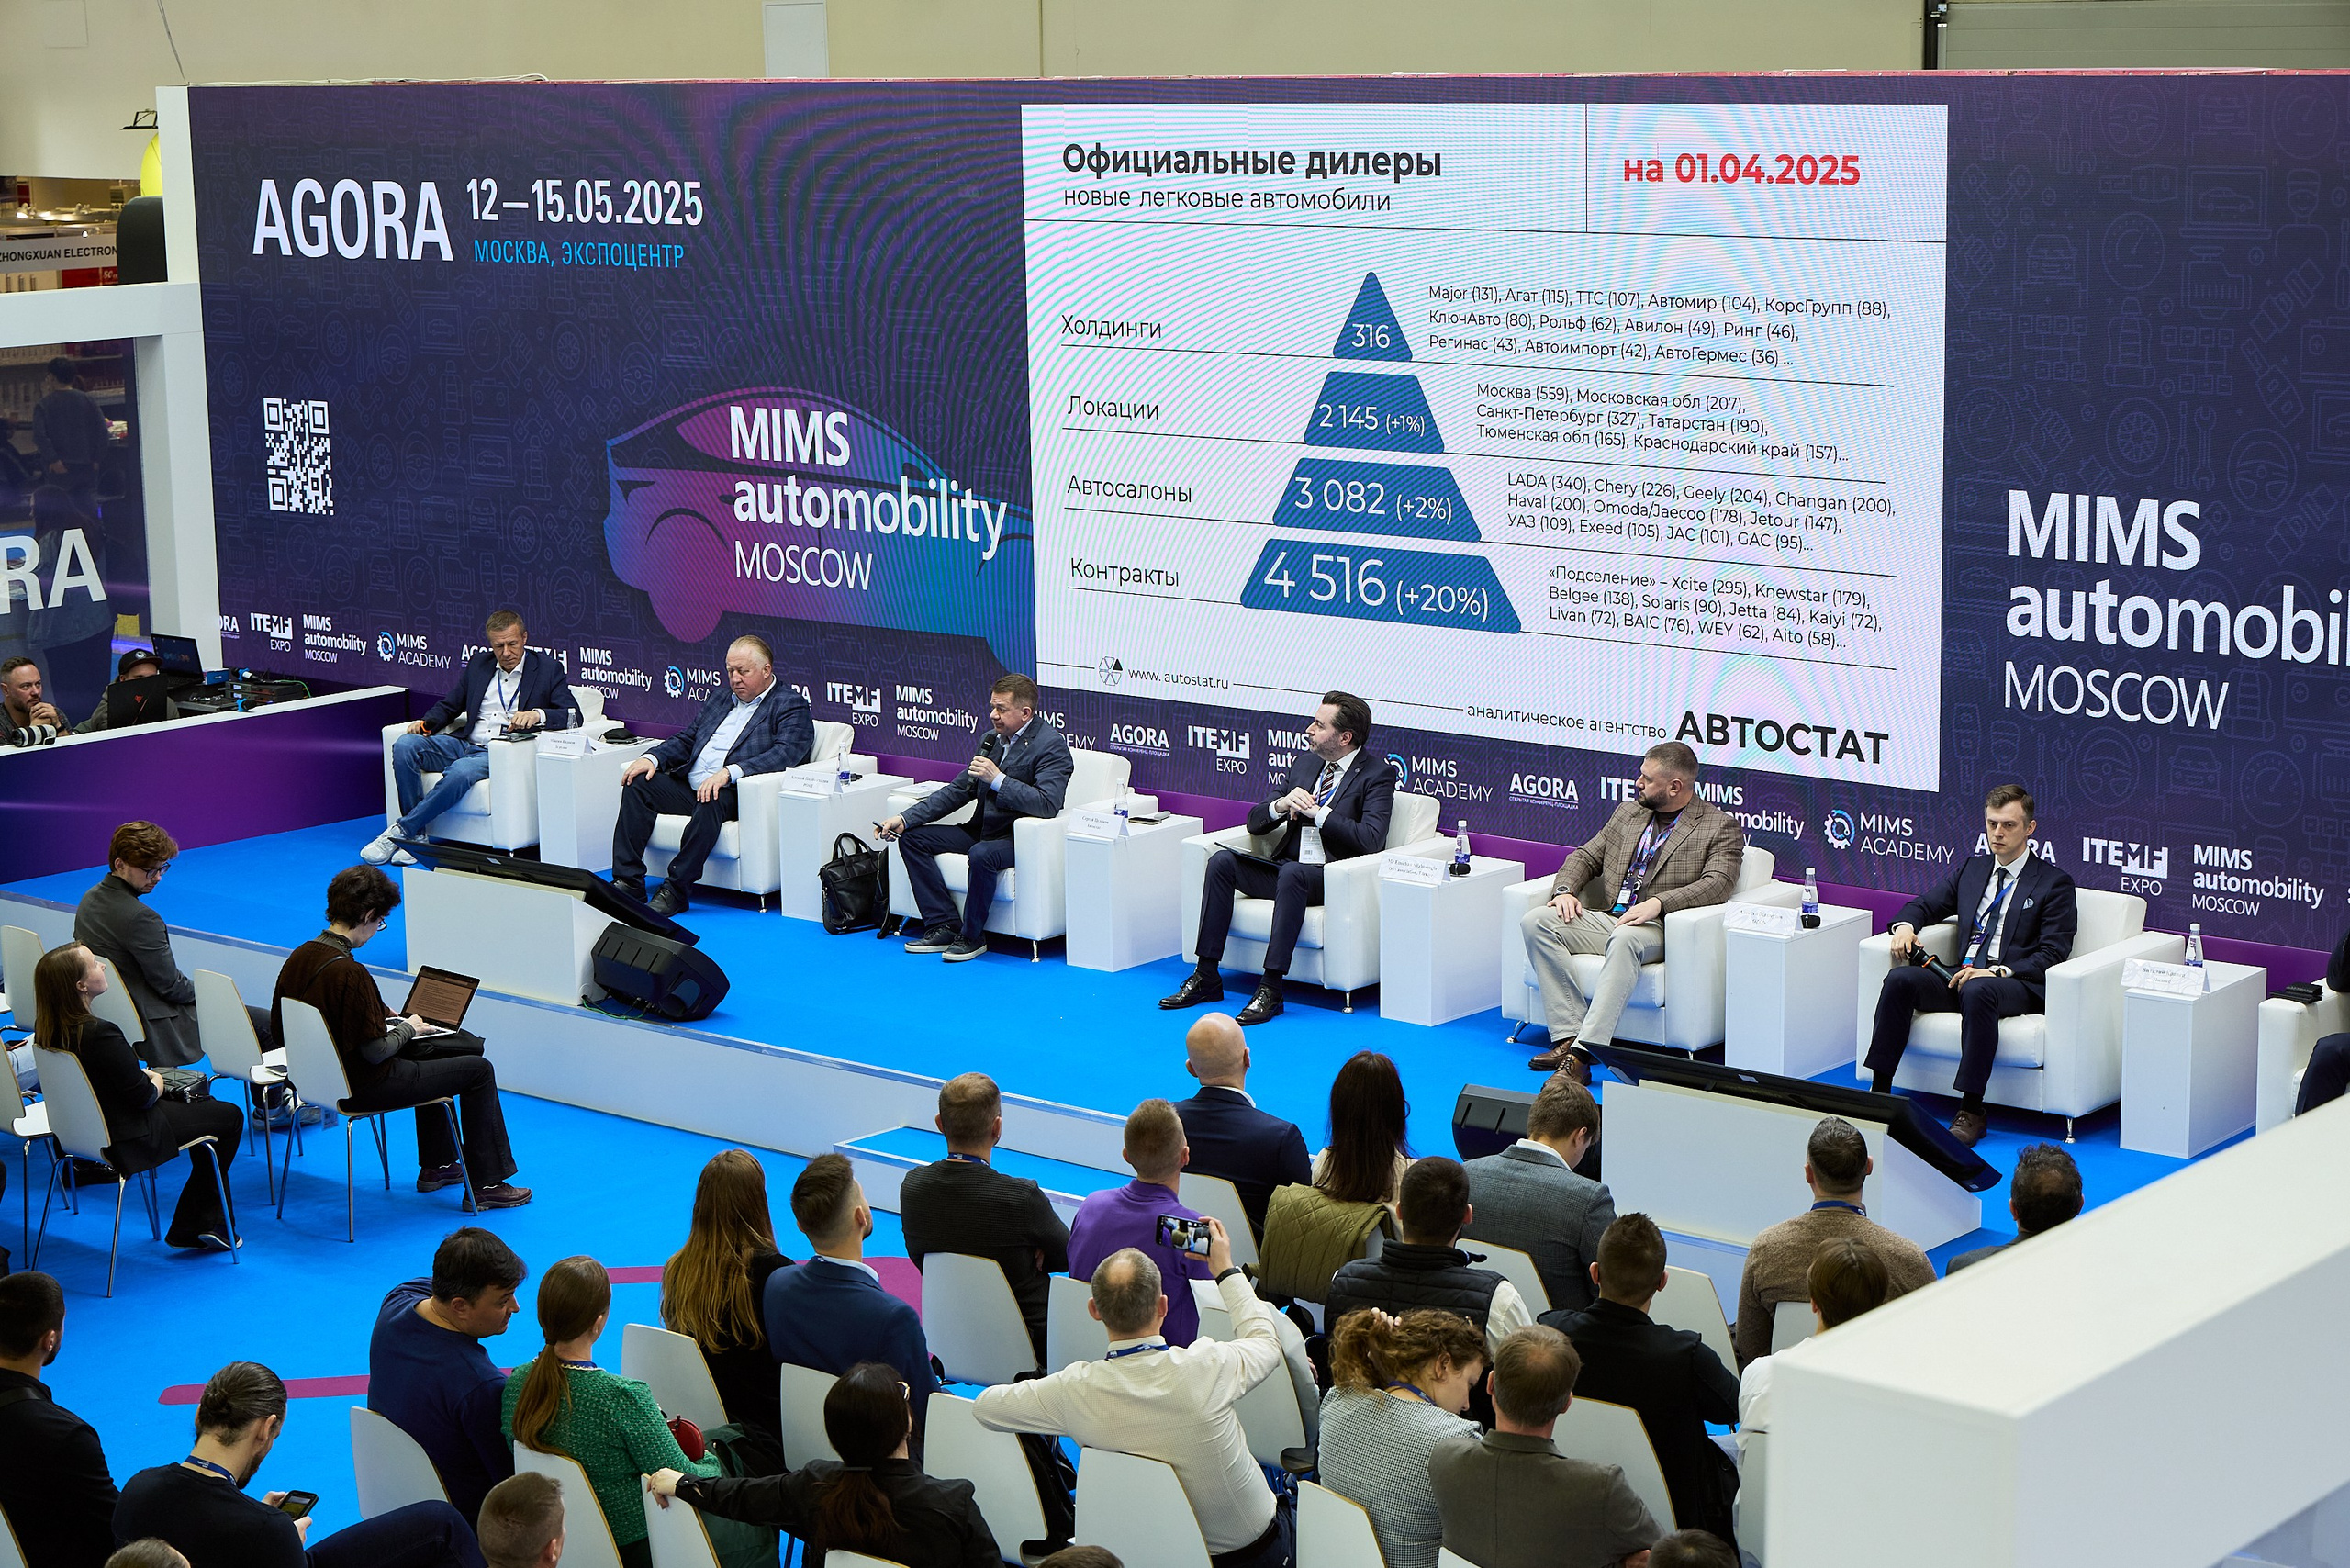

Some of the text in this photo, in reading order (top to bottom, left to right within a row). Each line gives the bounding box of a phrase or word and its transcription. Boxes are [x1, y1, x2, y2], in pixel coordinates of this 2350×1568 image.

[1062, 141, 1442, 185] Официальные дилеры
[1623, 152, 1861, 186] на 01.04.2025
[1064, 186, 1391, 211] новые легковые автомобили
[252, 177, 454, 262] AGORA
[474, 239, 685, 271] МОСКВА, ЭКСПОЦЕНТР
[1429, 285, 1468, 303] Major
[1472, 286, 1502, 304] (131),
[1505, 287, 1539, 303] Агат
[1541, 288, 1572, 308] (115),
[1608, 291, 1644, 310] (107),
[1647, 293, 1718, 313] Автомир
[1721, 295, 1761, 315] (104),
[1765, 297, 1852, 318] КорсГрупп
[1857, 300, 1891, 320] (88),
[1061, 314, 1161, 340] Холдинги
[1351, 323, 1391, 349] 316
[1429, 309, 1799, 342] КлючАвто (80), Рольф (62), Авилон (49), Ринг (46),
[1429, 334, 1779, 368] Регинас (43), Автоимпорт (42), АвтоГермес (36)
[1067, 395, 1158, 421] Локации
[1477, 383, 1746, 415] Москва (559), Московская обл (207),
[1385, 413, 1425, 438] (+1%)
[1476, 403, 1768, 438] Санкт-Петербург (327), Татарстан (190),
[730, 405, 851, 467] MIMS
[1477, 425, 1850, 465] Тюменская обл (165), Краснодарский край (157)...
[1067, 474, 1192, 503] Автосалоны
[1507, 472, 1896, 517] LADA (340), Chery (226), Geely (204), Changan (200),
[733, 474, 1008, 561] automobility
[1396, 493, 1452, 526] (+2%)
[1507, 492, 1841, 535] Haval (200), Omoda/Jaecoo (178), Jetour (147),
[1507, 513, 1815, 554] УАЗ (109), Exeed (105), JAC (101), GAC (95)...
[2007, 489, 2201, 571] MIMS
[734, 540, 873, 591] MOSCOW
[1070, 557, 1179, 588] Контракты
[1396, 579, 1489, 623] (+20%)
[1549, 566, 1870, 610] «Подселение» Xcite (295), Knewstar (179),
[302, 613, 332, 632] MIMS
[1550, 585, 1882, 633] Belgee (138), Solaris (90), Jetta (84), Kaiyi (72),
[397, 633, 428, 651] MIMS
[1550, 605, 1847, 651] Livan (72), BAIC (76), WEY (62), Aito (58)...
[270, 639, 291, 653] EXPO
[304, 632, 367, 656] automobility
[304, 648, 338, 664] MOSCOW
[579, 646, 613, 666] MIMS
[397, 650, 452, 669] ACADEMY
[580, 666, 653, 692] automobility
[686, 667, 722, 687] MIMS
[895, 684, 933, 705] MIMS
[2005, 661, 2230, 730] MOSCOW
[852, 711, 878, 728] EXPO
[896, 705, 979, 734] automobility
[897, 723, 940, 741] MOSCOW
[1467, 705, 1667, 739] аналитическое агентство
[1110, 722, 1170, 749] AGORA
[1267, 728, 1311, 752] MIMS
[1674, 711, 1889, 765] АВТОСТАТ
[1216, 757, 1247, 775] EXPO
[1412, 756, 1458, 778] MIMS
[1412, 777, 1494, 803] ACADEMY
[1509, 772, 1580, 801] AGORA
[1694, 781, 1744, 806] MIMS
[1860, 812, 1913, 837] MIMS
[1860, 835, 1955, 865] ACADEMY
[2193, 844, 2253, 871] MIMS
[2121, 876, 2163, 896] EXPO
[2192, 871, 2325, 910] automobility
[2192, 893, 2260, 917] MOSCOW
